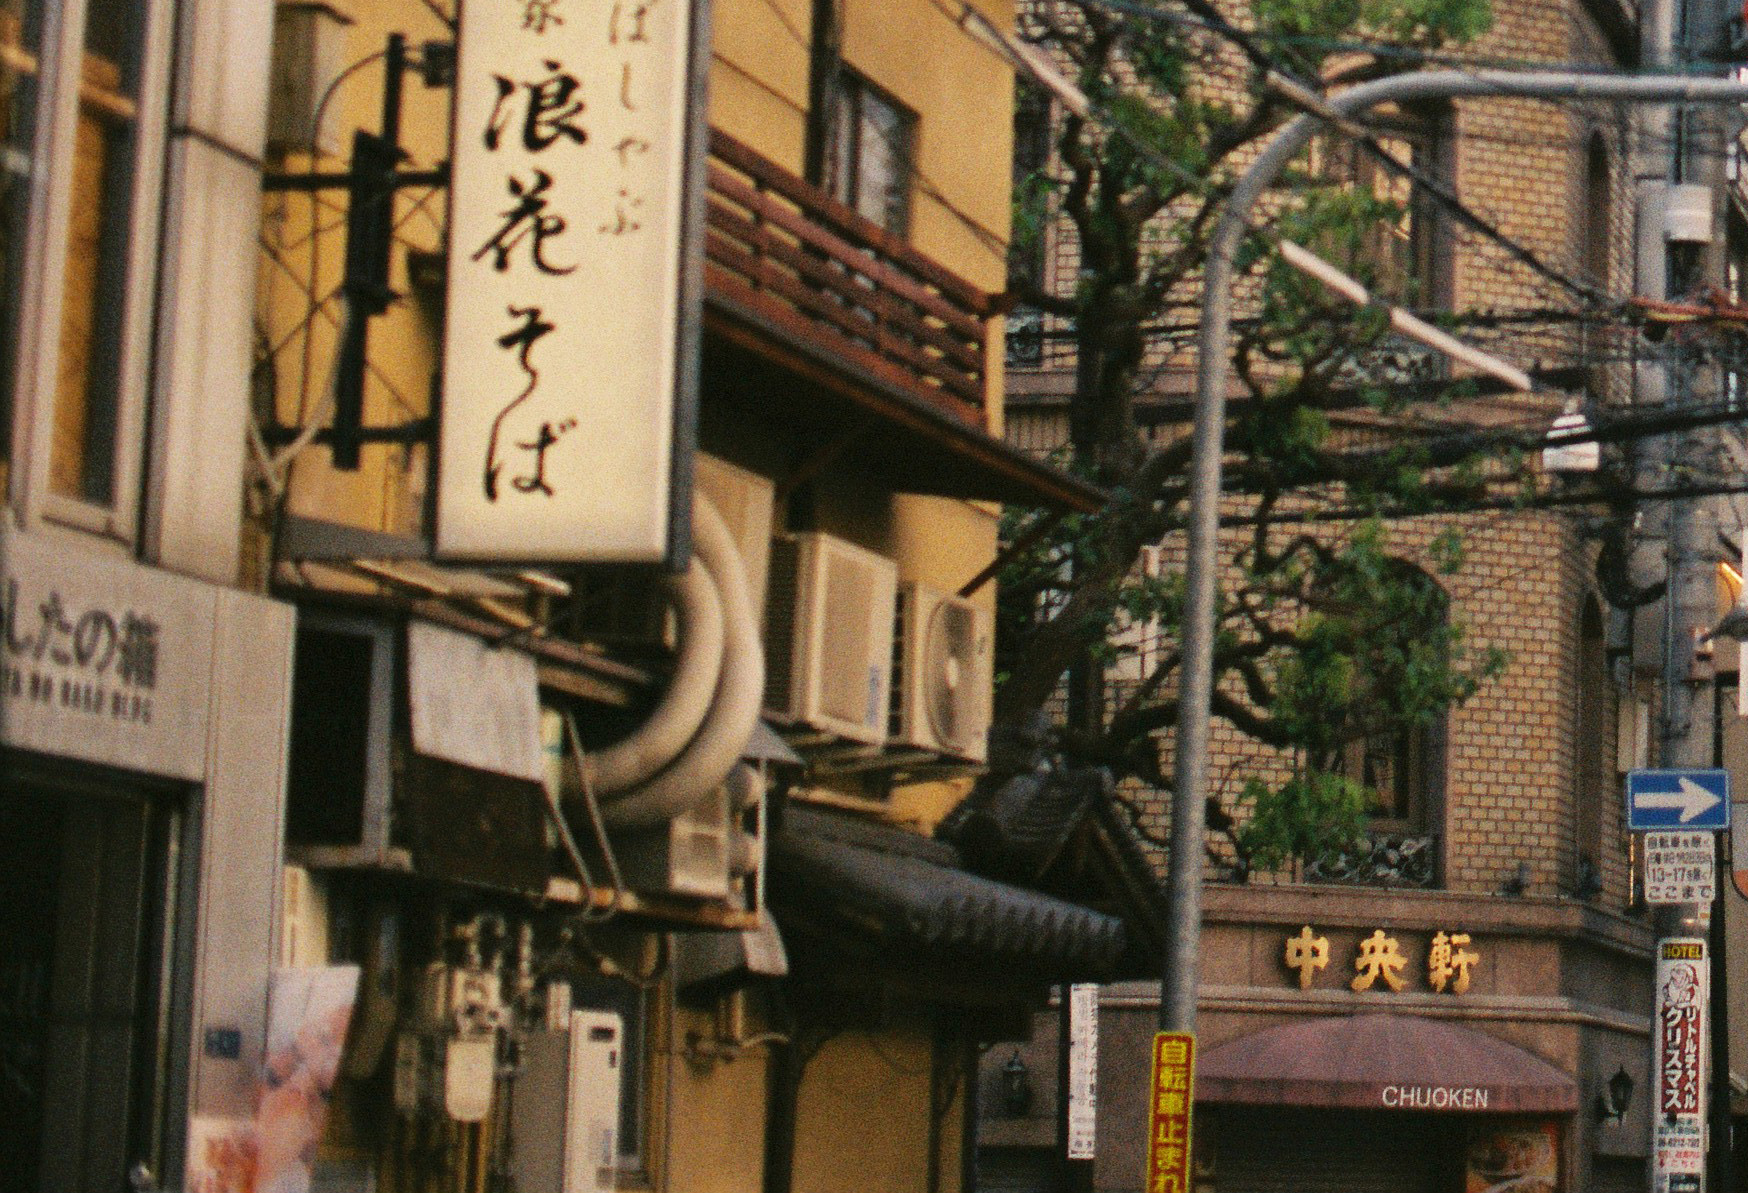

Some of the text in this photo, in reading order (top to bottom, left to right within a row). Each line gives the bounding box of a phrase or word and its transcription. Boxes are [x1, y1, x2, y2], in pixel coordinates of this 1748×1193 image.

[1648, 885, 1712, 900] ここまで
[1286, 925, 1480, 995] 中央軒
[1663, 945, 1702, 958] HOTEL
[1664, 1008, 1683, 1109] クリスマス
[1382, 1085, 1488, 1108] CHUOKEN
